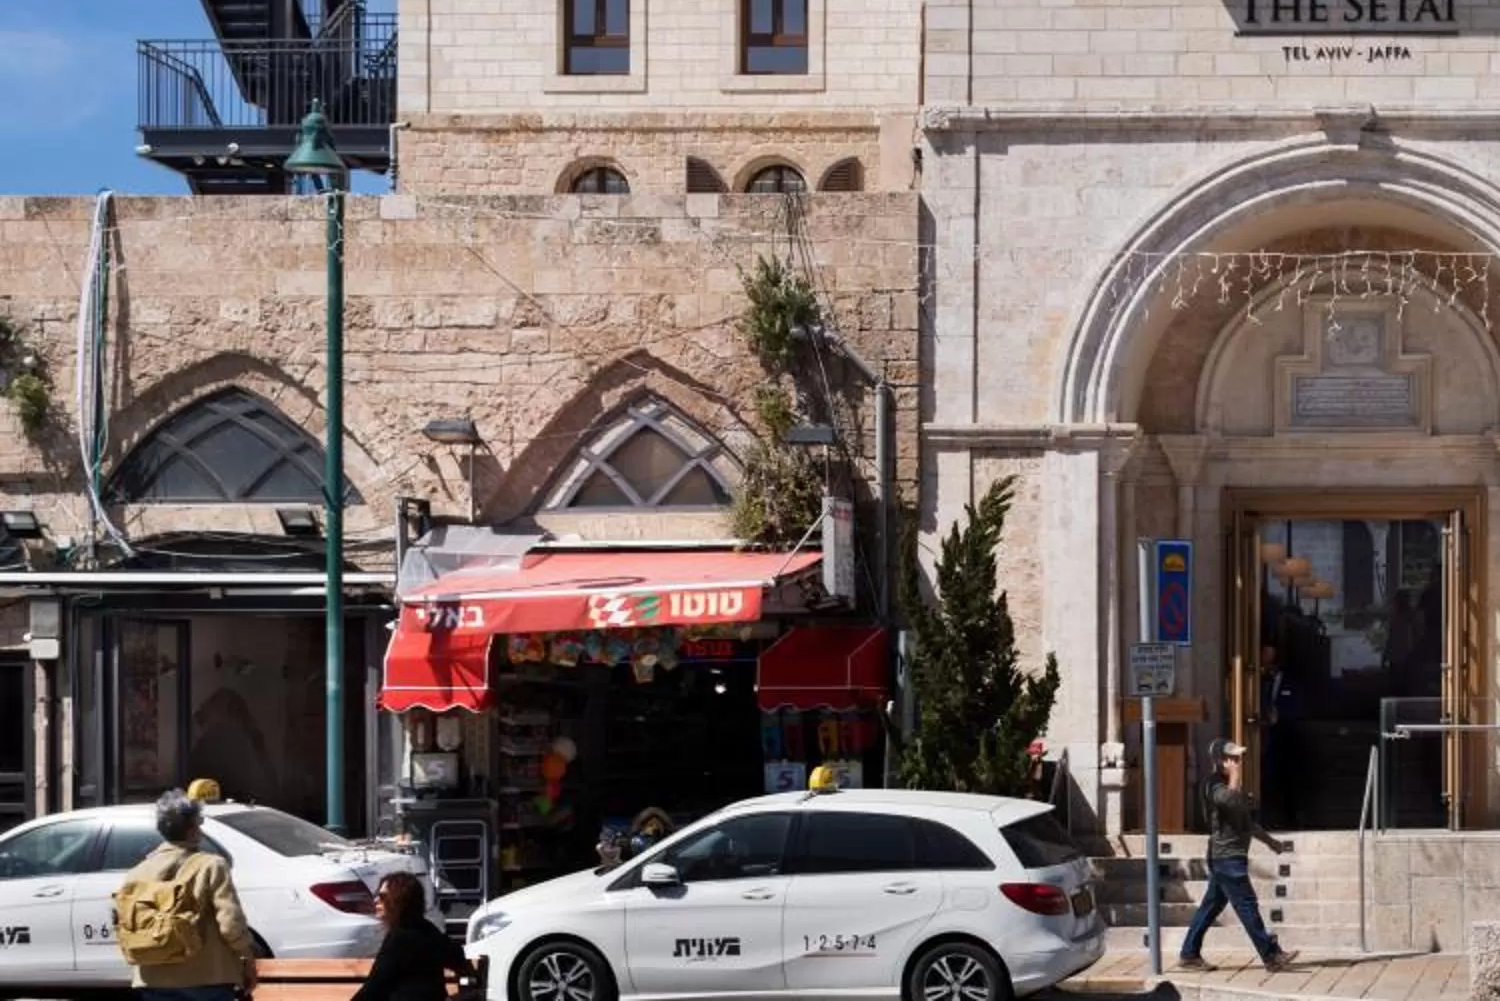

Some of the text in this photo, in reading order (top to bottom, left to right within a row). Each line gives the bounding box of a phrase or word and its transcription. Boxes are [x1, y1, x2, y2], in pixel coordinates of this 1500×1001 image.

[1281, 46, 1310, 62] TEL
[1316, 46, 1352, 61] AVIV
[1367, 46, 1411, 63] JAFFA
[670, 589, 743, 618] טוטו
